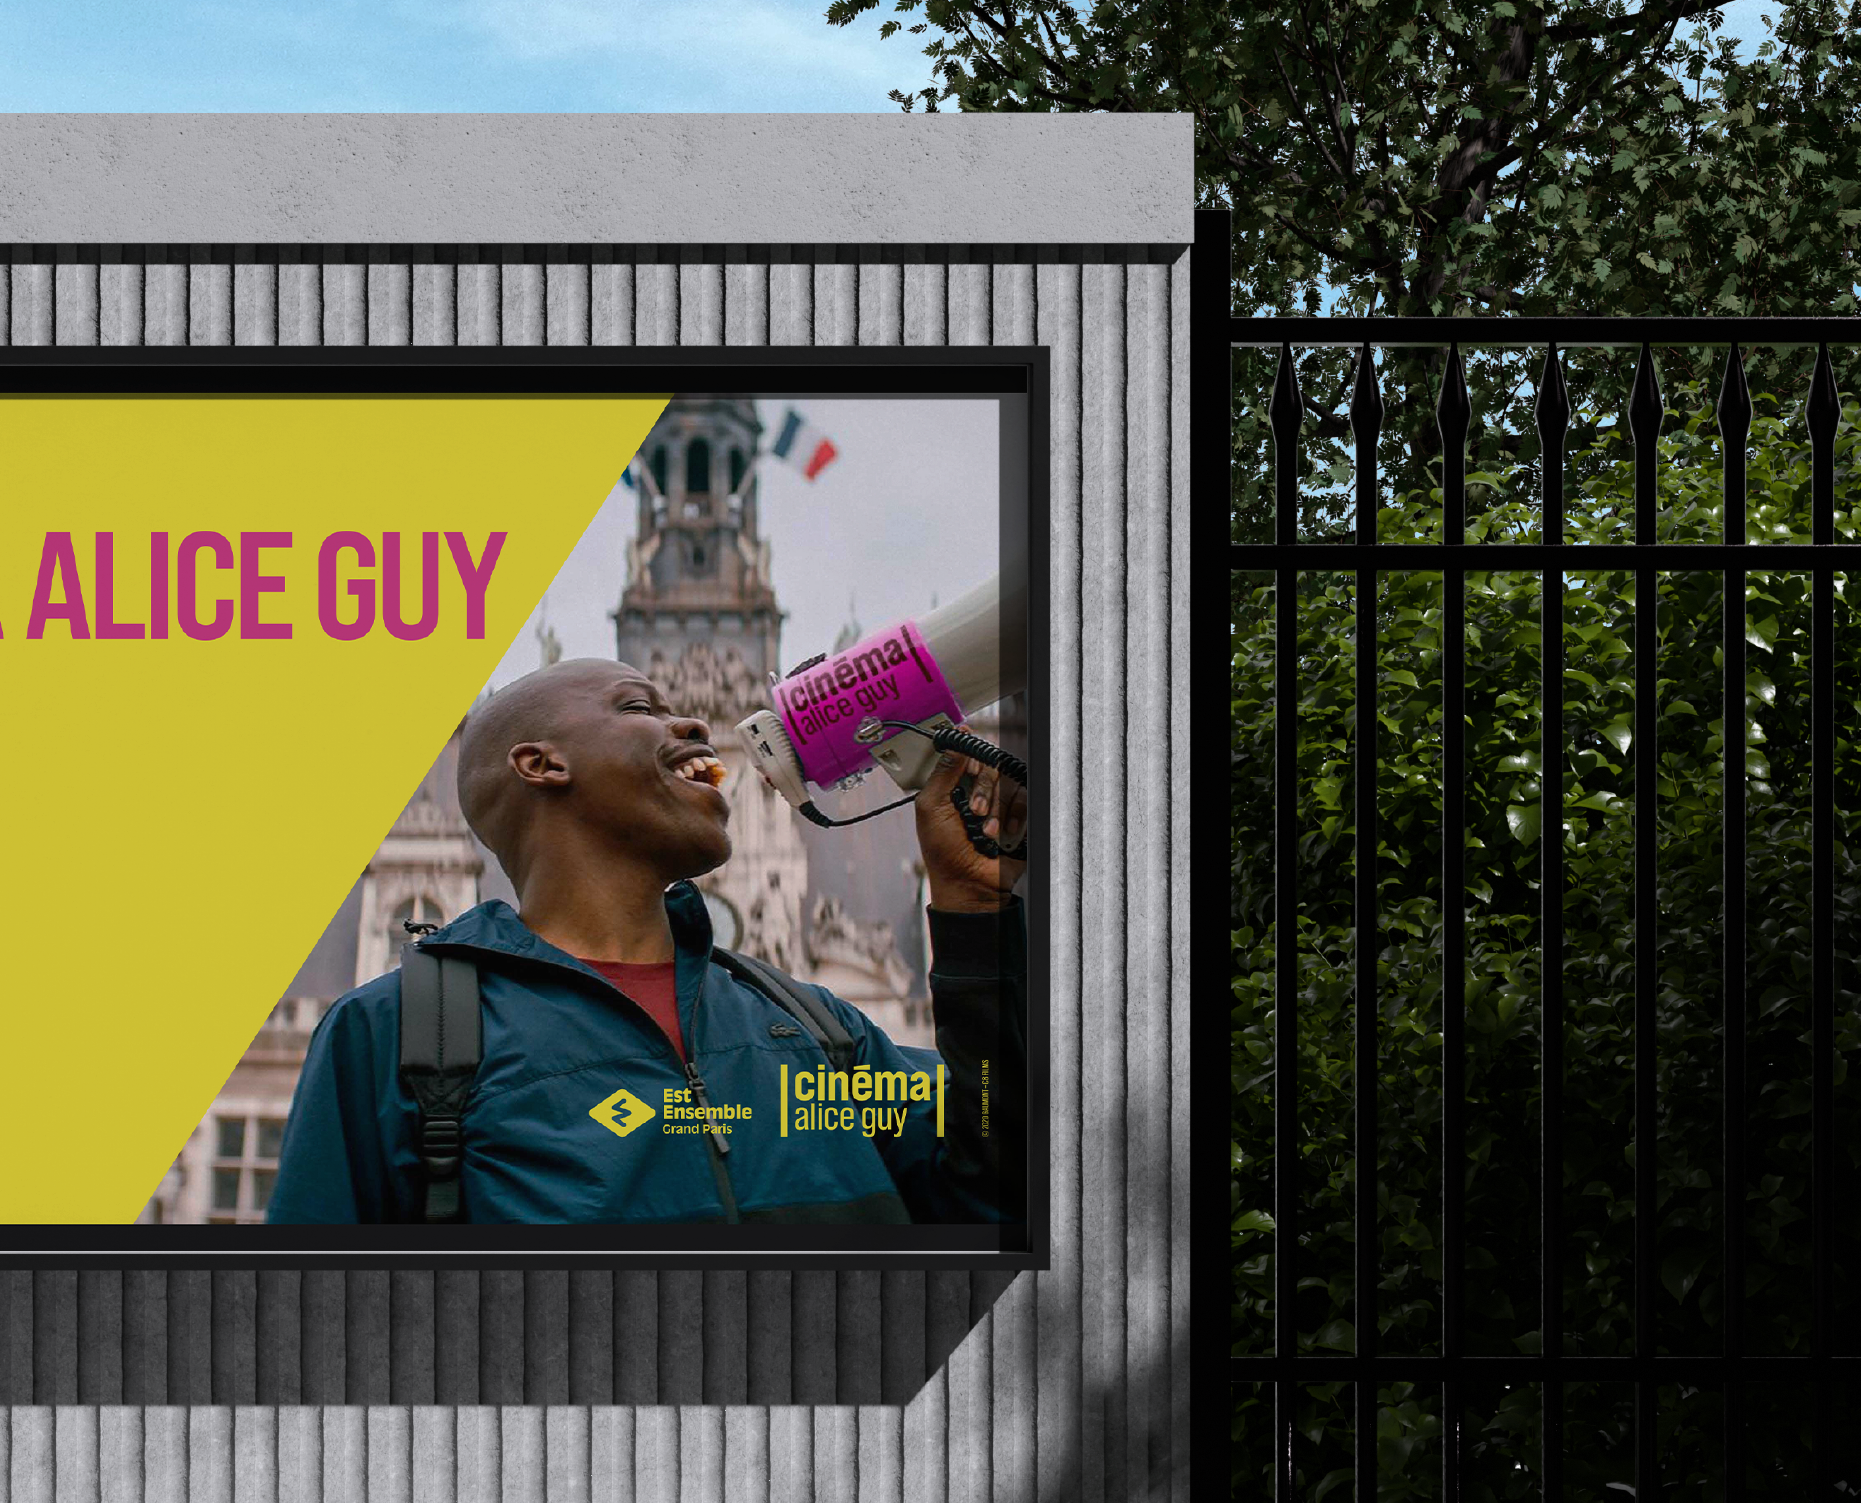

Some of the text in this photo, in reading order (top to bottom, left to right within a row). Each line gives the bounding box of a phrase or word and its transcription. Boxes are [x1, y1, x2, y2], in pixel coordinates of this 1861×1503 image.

[25, 530, 293, 642] ALICE
[317, 530, 509, 642] GUY
[801, 672, 901, 737] alice guy
[663, 1087, 692, 1103] Est
[794, 1064, 932, 1102] cinéma
[662, 1123, 733, 1135] Grand Paris
[663, 1104, 753, 1120] Ensemble
[794, 1103, 908, 1138] alice guy
